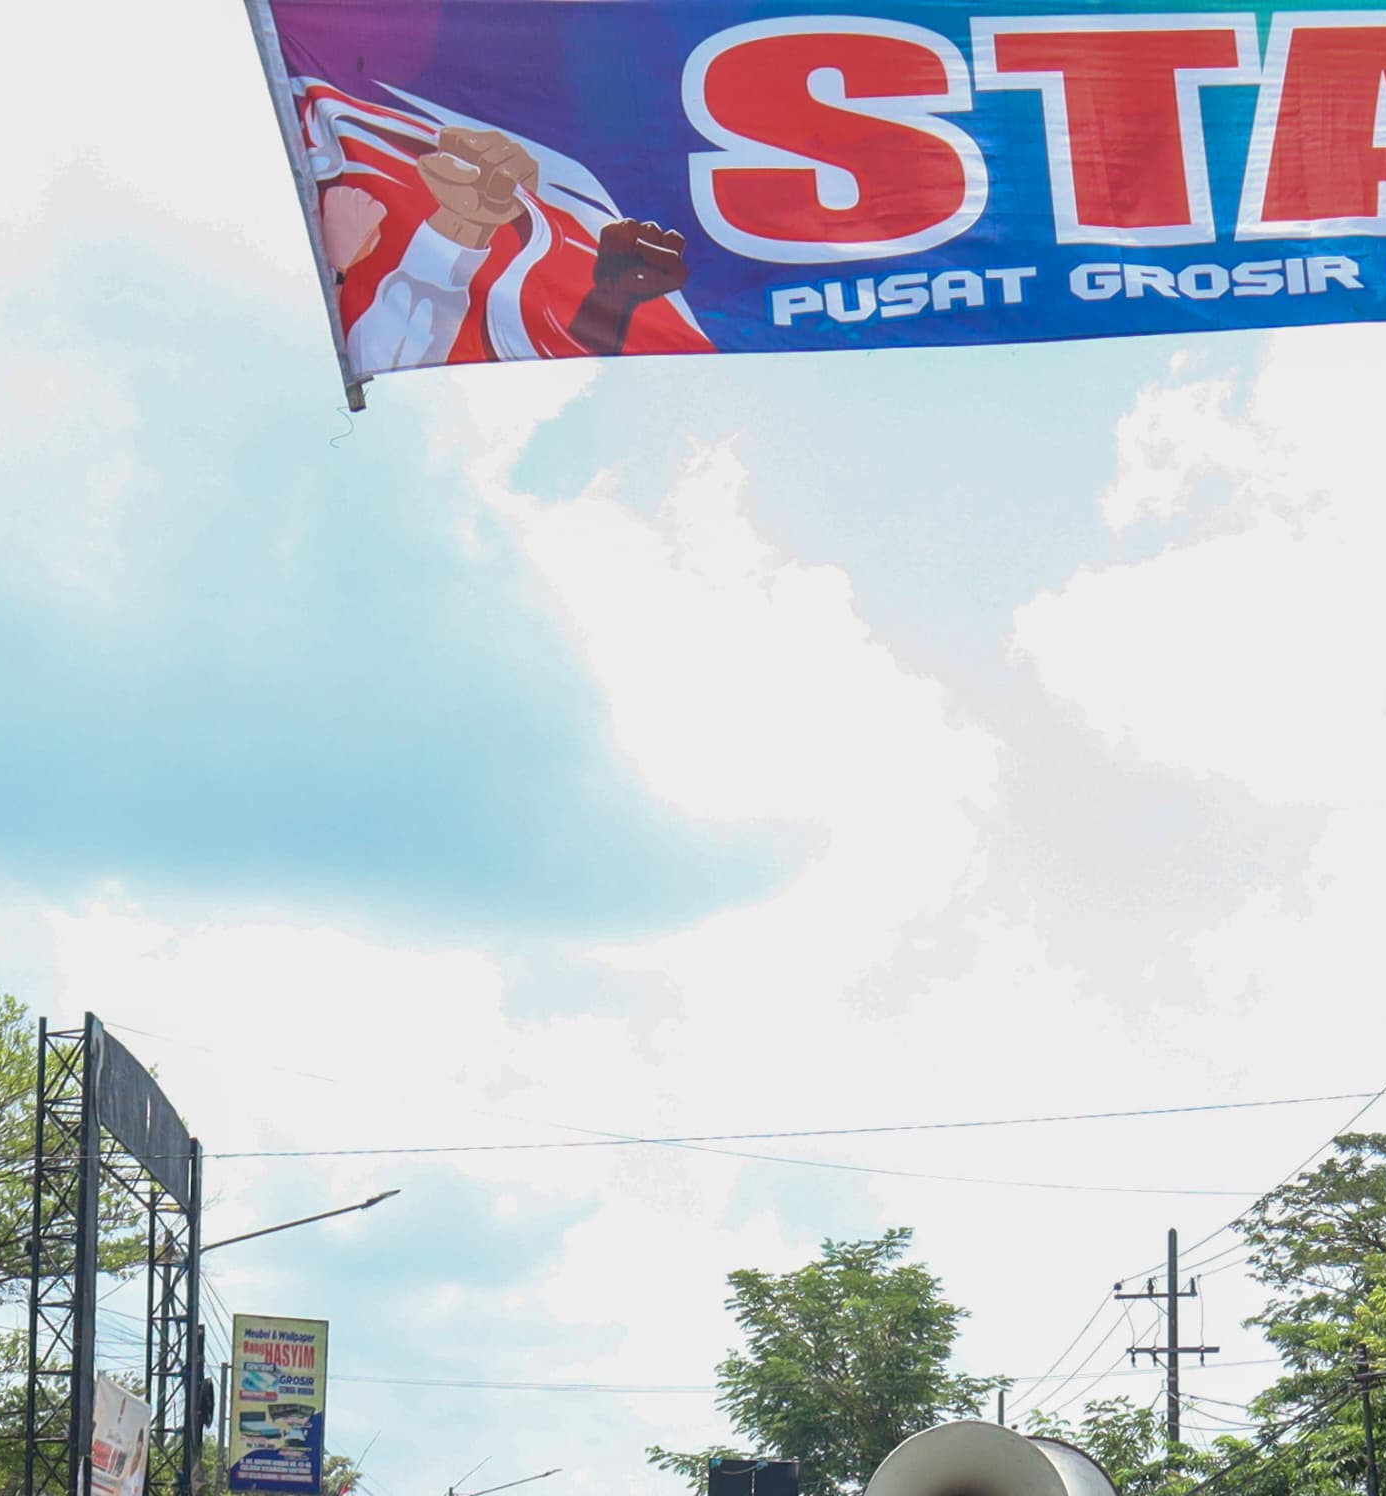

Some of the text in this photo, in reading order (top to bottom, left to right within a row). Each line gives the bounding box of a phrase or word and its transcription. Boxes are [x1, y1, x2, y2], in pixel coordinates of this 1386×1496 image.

[771, 266, 1036, 326] PUSAT
[1069, 256, 1364, 299] GROSIR
[265, 1342, 315, 1369] HASYIM
[279, 1375, 315, 1386] GROSIR
